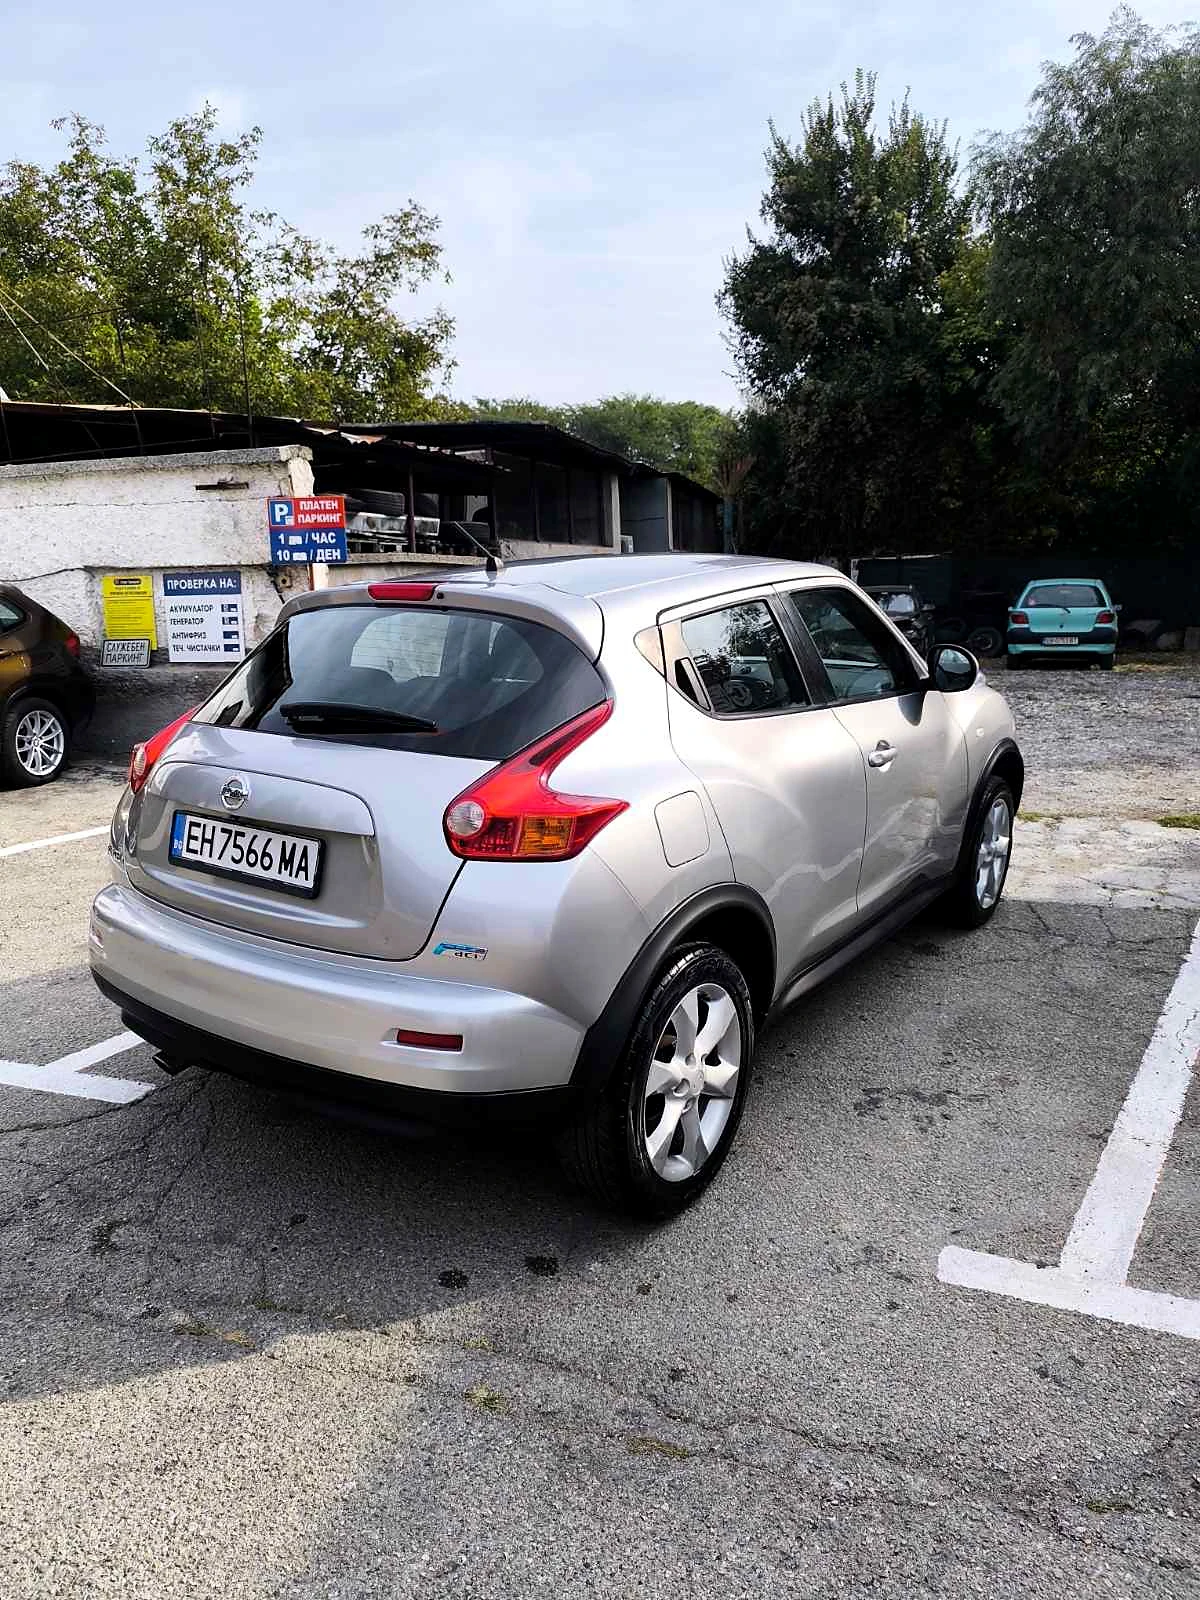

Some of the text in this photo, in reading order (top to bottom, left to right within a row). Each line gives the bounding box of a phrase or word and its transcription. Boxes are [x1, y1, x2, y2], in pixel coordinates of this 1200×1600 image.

[299, 500, 339, 511] ПЛАТЕН
[297, 513, 343, 524] ПАРКИНГ
[278, 533, 285, 545] 1
[311, 532, 337, 544] ЧАС
[276, 549, 290, 562] 10
[316, 548, 341, 562] ДЕН
[167, 578, 237, 590] ПРОВЕРКА НА:
[169, 604, 214, 613] АКУМУЛАТОР
[170, 617, 204, 626] ГЕНЕРАТОР
[171, 631, 207, 640] АНТИФРИЗ
[106, 642, 145, 653] СЛУЖЕБЕН
[187, 643, 221, 653] ЧИСТАЧКИ
[105, 653, 145, 664] ПАРКИНГ
